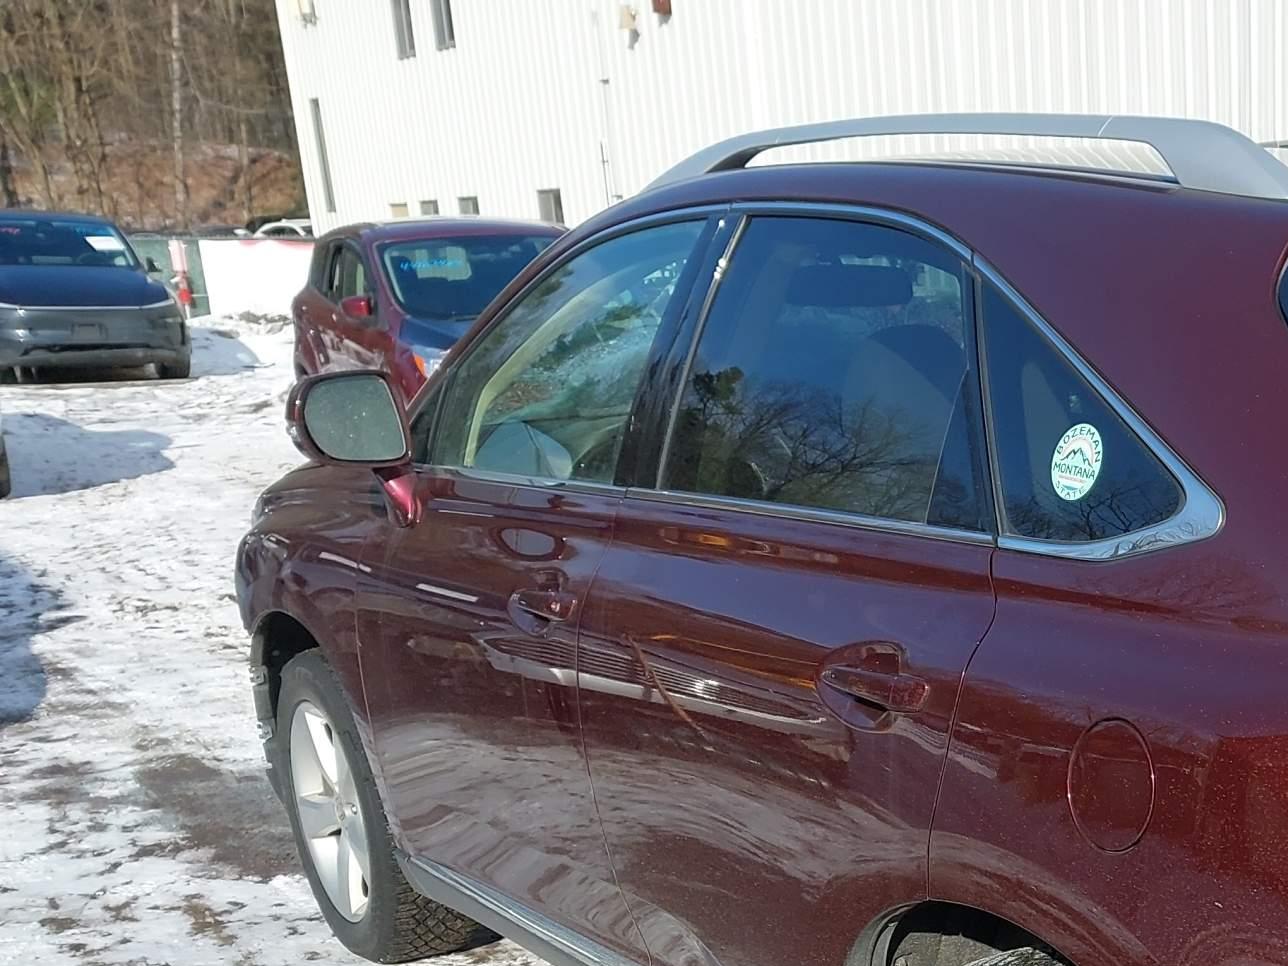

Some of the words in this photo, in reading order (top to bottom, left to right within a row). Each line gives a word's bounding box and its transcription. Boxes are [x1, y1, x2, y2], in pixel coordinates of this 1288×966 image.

[1056, 426, 1101, 463] BOZEMAN
[1053, 461, 1096, 480] MONTANA
[1055, 480, 1086, 498] STATE
